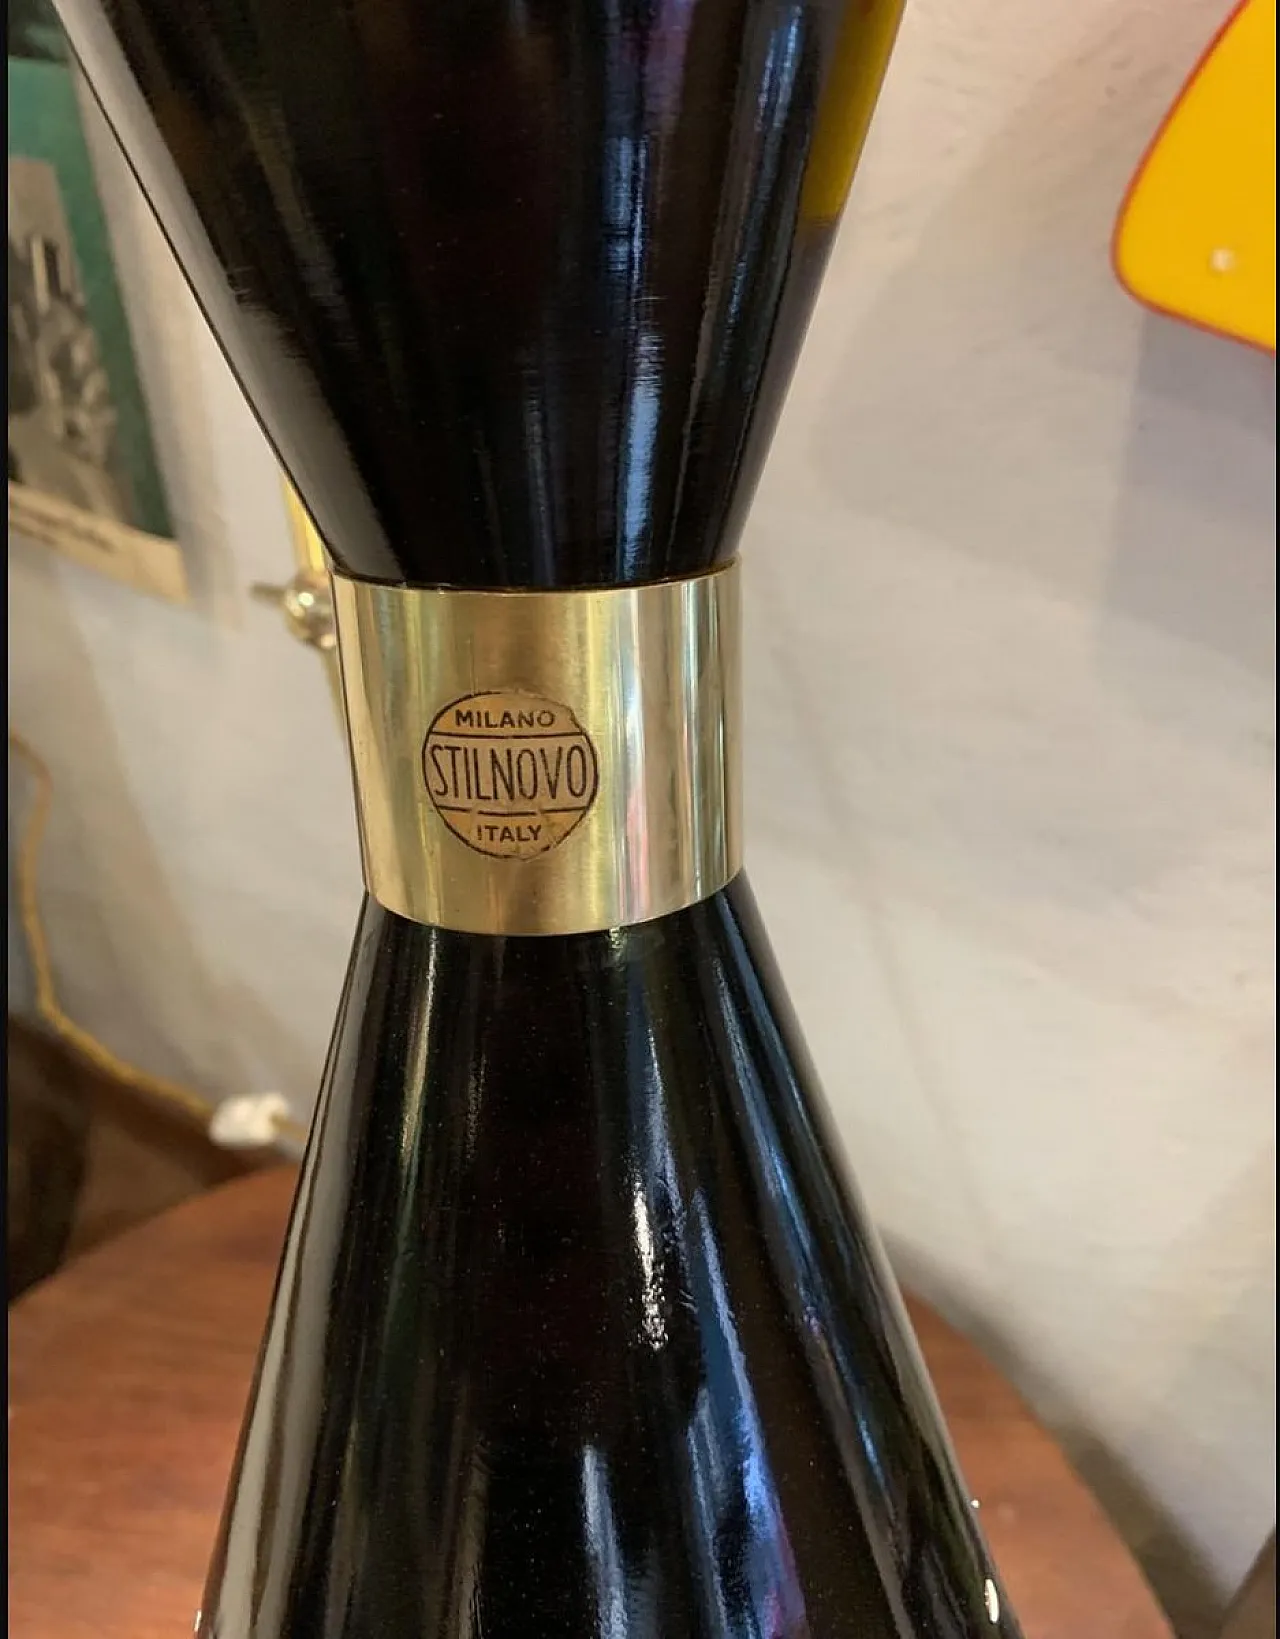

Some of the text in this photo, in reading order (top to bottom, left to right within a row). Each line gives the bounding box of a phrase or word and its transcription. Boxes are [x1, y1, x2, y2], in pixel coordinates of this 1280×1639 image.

[455, 709, 556, 729] MILANO
[429, 744, 587, 800] STILNOVO
[477, 824, 542, 842] ITALY
